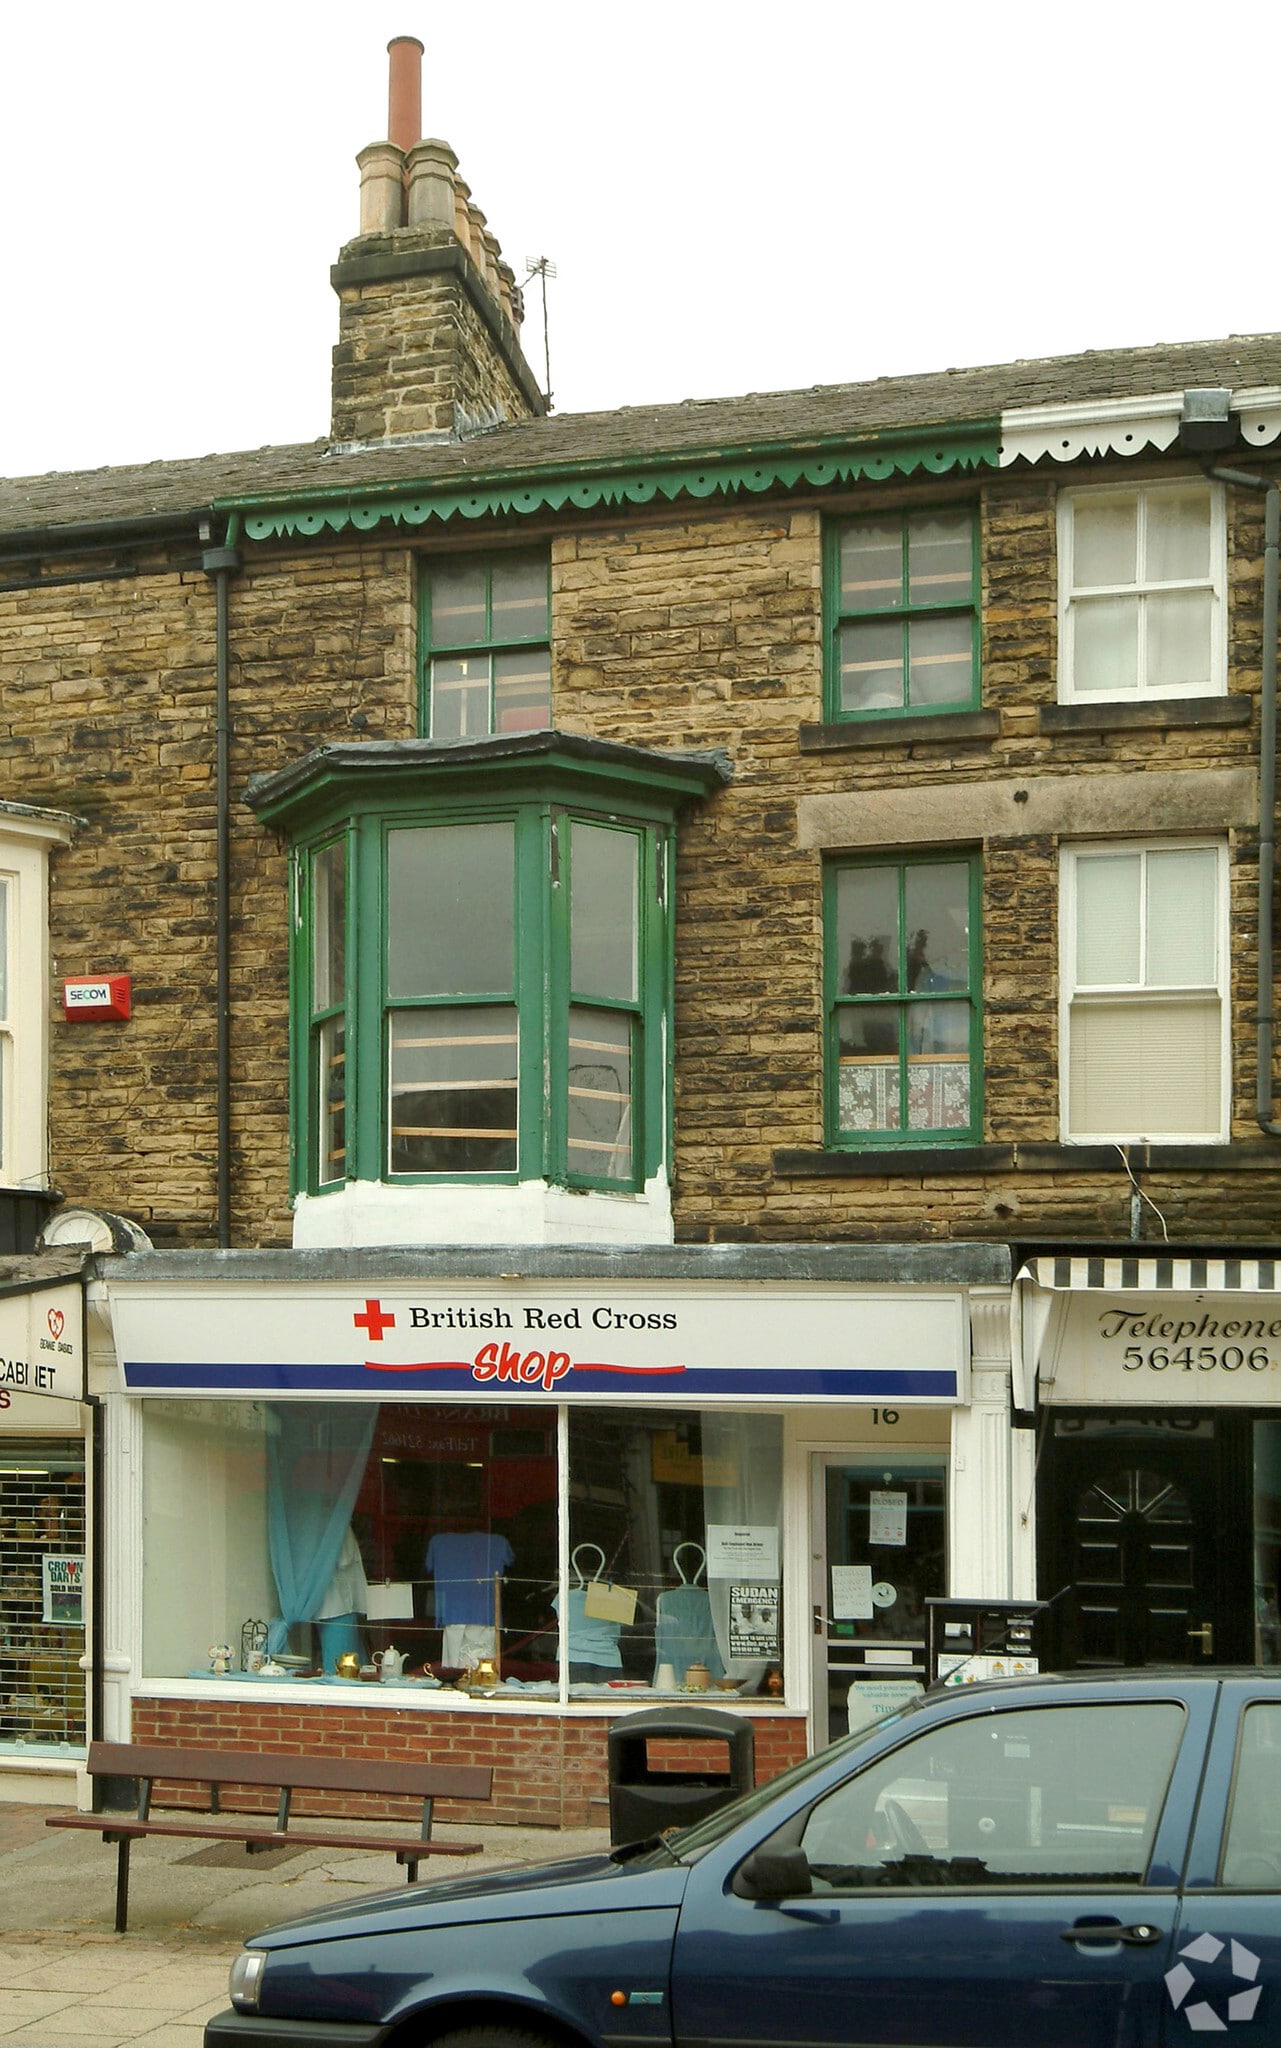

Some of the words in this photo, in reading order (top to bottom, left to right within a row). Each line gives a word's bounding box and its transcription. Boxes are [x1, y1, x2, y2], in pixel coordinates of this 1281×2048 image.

[70, 989, 107, 1001] SECOM
[409, 1307, 513, 1329] British
[523, 1308, 582, 1329] Red
[591, 1308, 677, 1329] Cross
[1098, 1309, 1281, 1344] Telephone
[472, 1341, 571, 1390] Shop
[1121, 1346, 1270, 1372] 564506
[871, 1408, 899, 1424] 16
[48, 1561, 83, 1573] CROWN
[50, 1571, 80, 1584] DARTS
[731, 1587, 778, 1598] SUDAN
